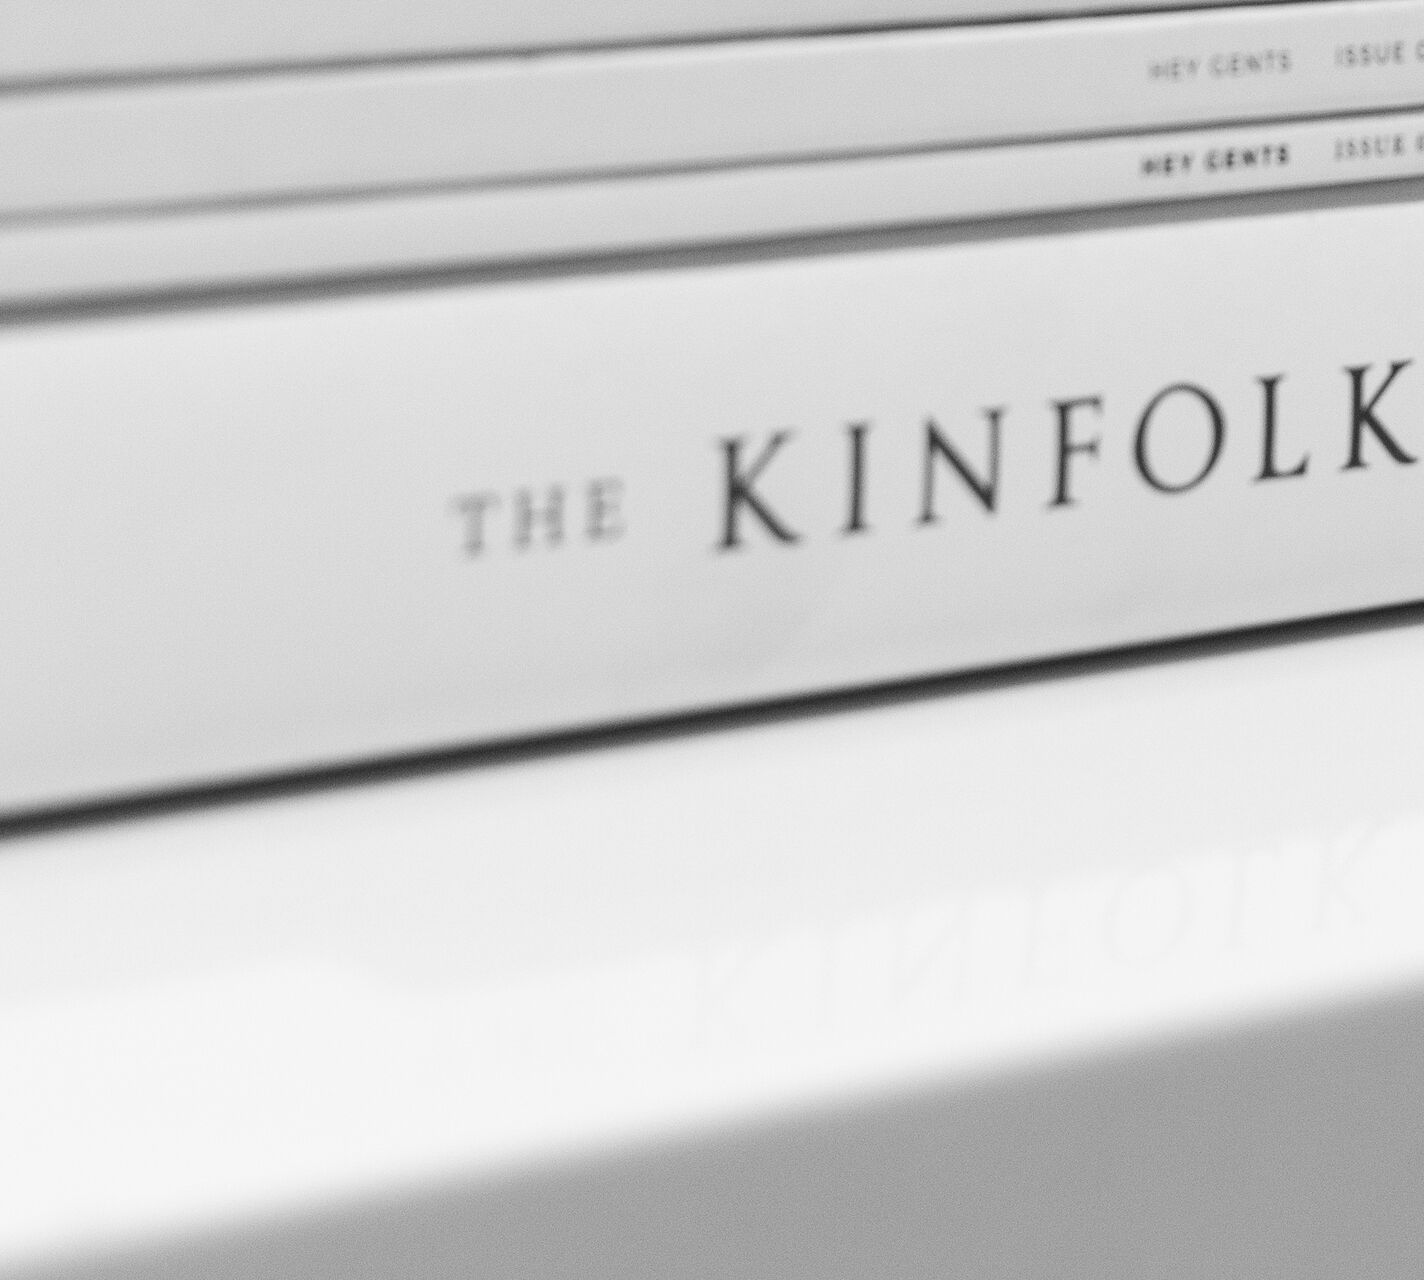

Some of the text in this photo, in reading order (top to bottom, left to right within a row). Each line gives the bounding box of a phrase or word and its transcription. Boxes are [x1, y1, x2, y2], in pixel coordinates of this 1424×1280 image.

[1147, 56, 1200, 83] HEY
[1209, 49, 1292, 78] CENTS
[1335, 40, 1405, 68] ISSUE
[1140, 153, 1194, 178] HEY
[1204, 144, 1290, 173] CENTS
[1334, 134, 1406, 161] ISSUE
[454, 477, 624, 560] THE
[717, 359, 1418, 553] KINFOLK
